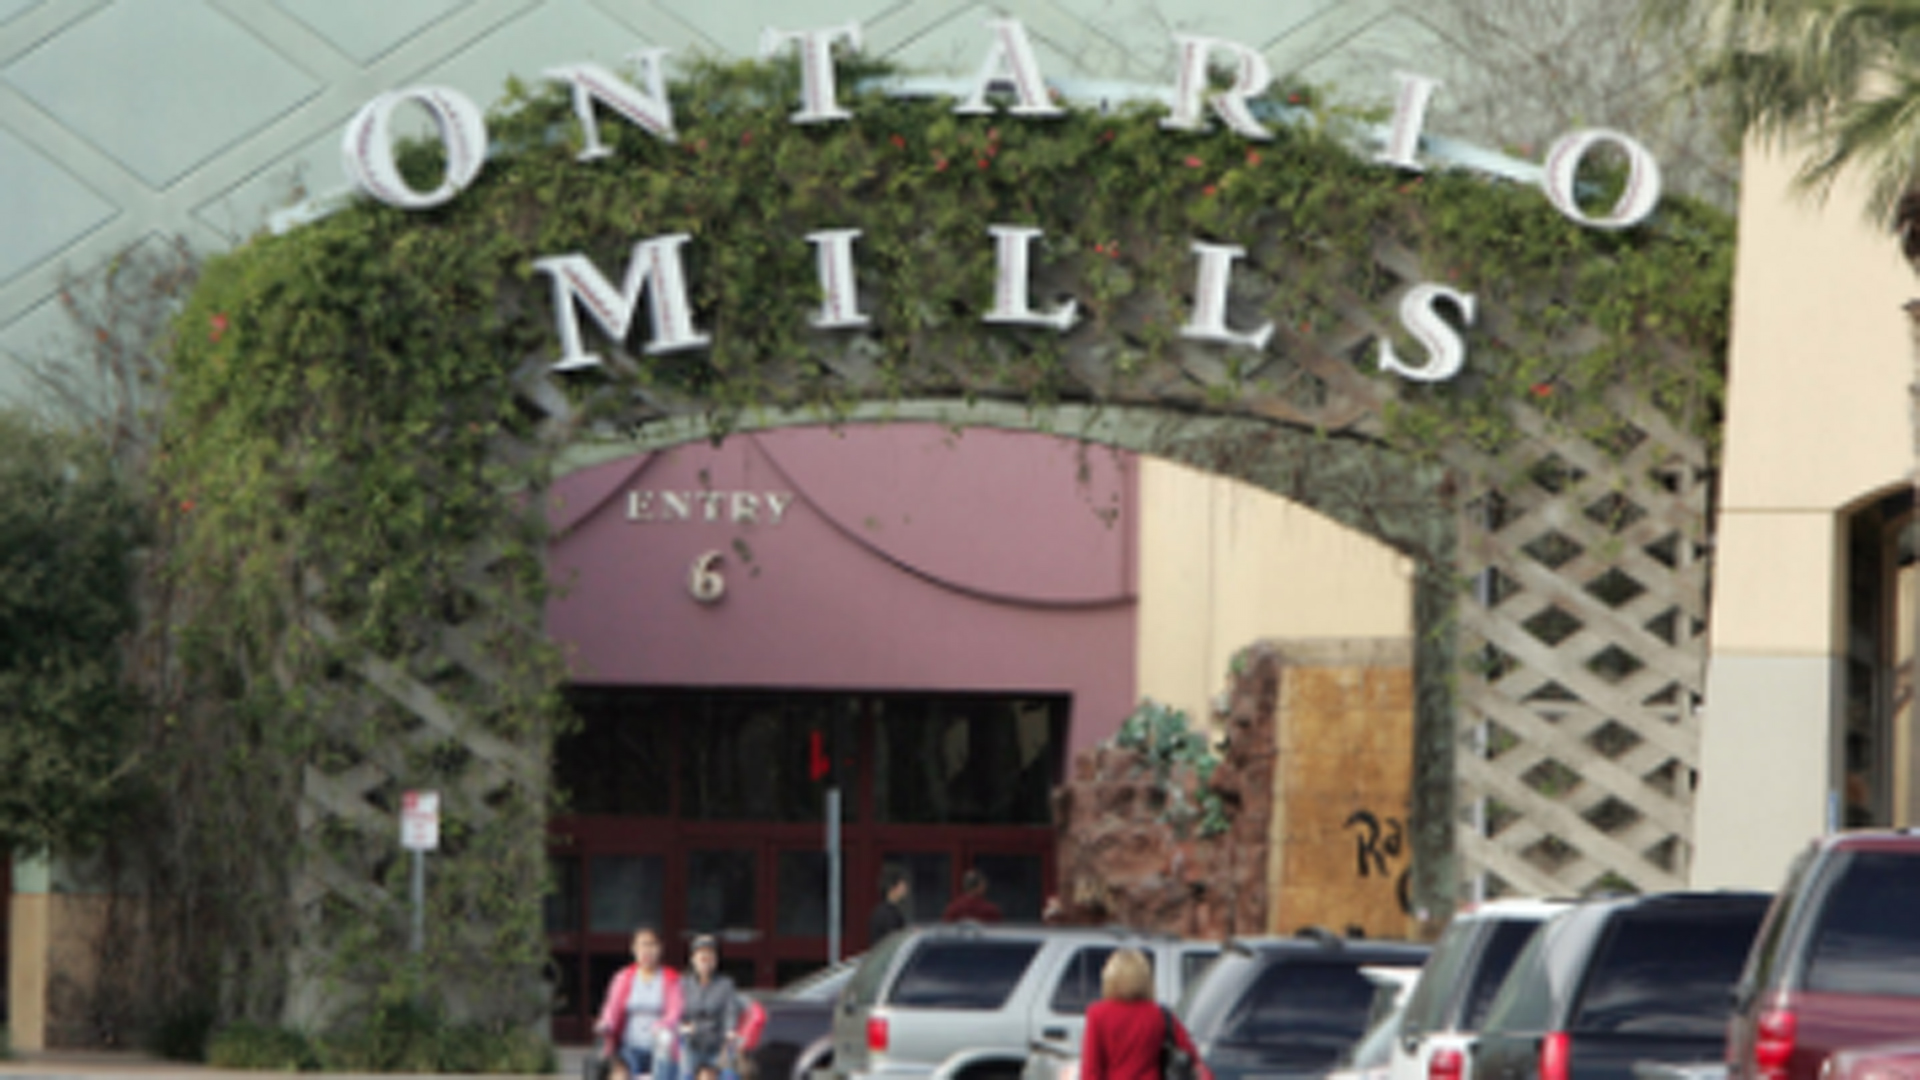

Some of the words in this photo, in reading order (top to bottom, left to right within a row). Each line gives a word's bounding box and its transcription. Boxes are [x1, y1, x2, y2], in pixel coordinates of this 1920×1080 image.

[341, 17, 1662, 230] ONTARIO
[533, 225, 1478, 382] MILLS
[627, 490, 795, 525] ENTRY
[690, 550, 726, 601] 6
[1343, 809, 1412, 878] Ra
